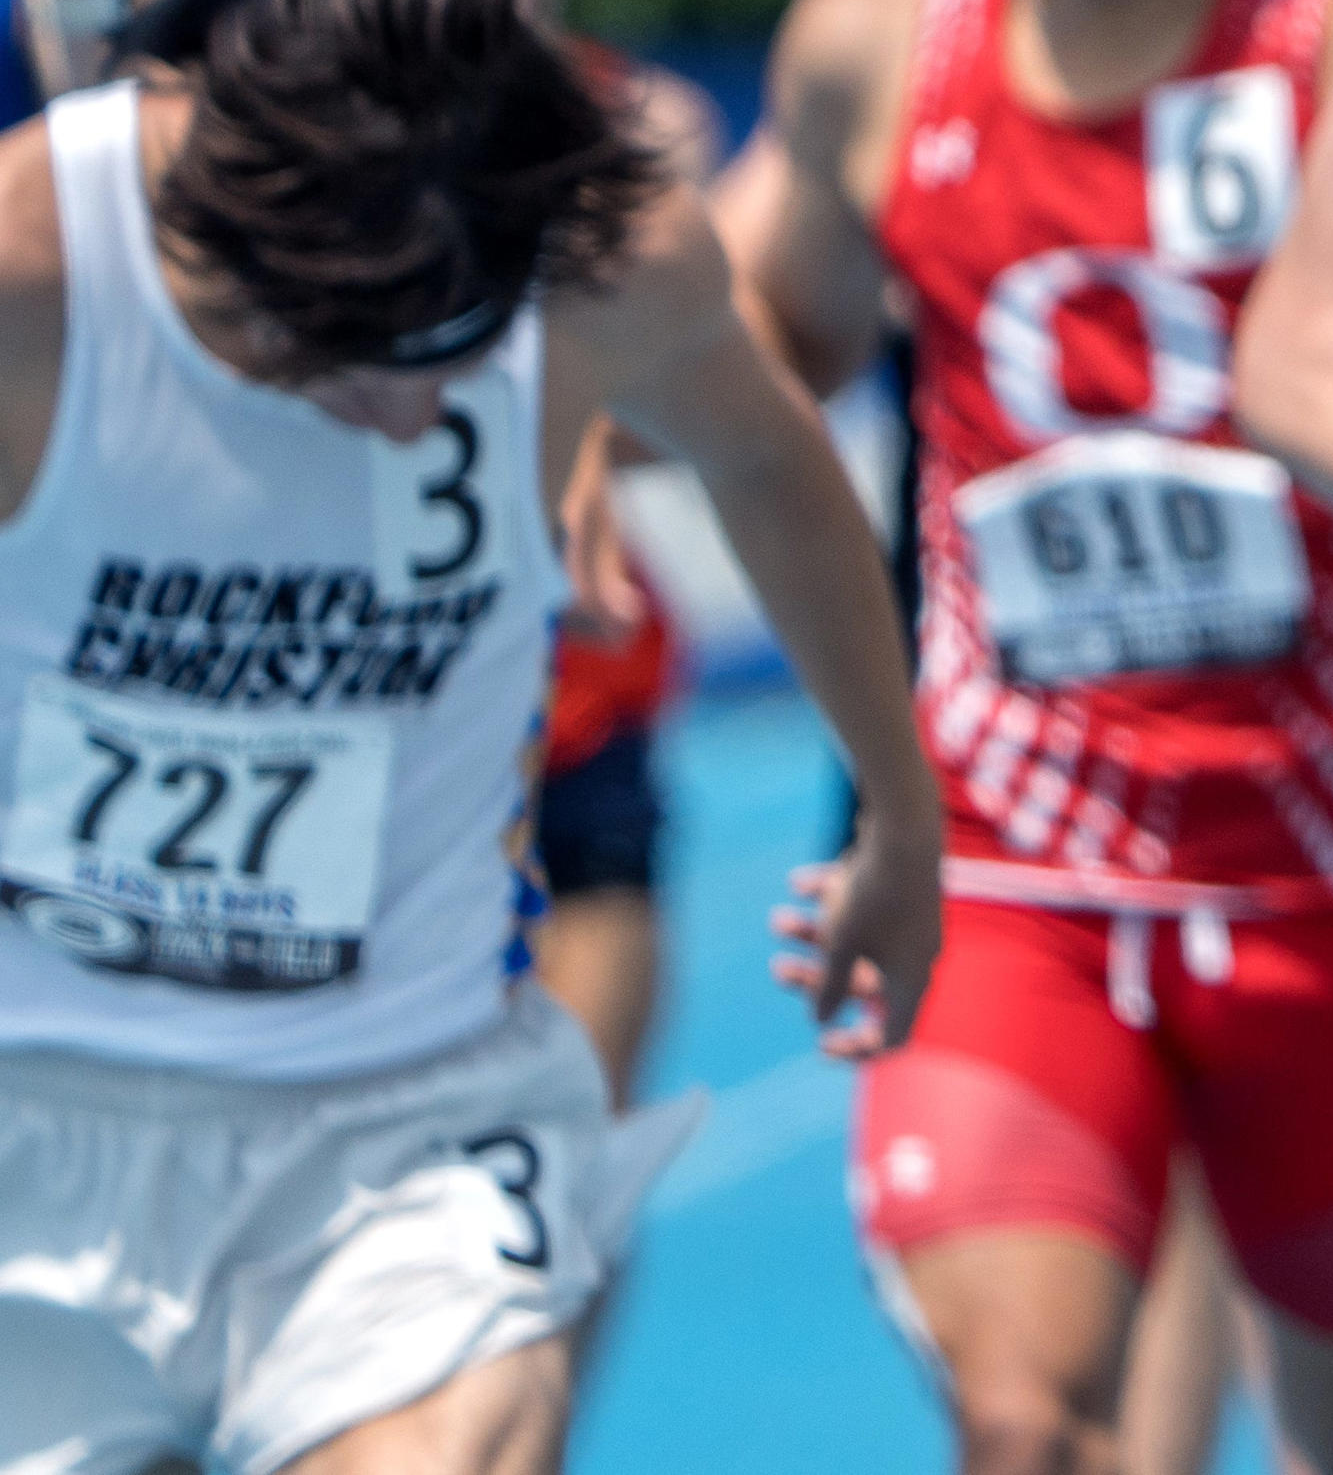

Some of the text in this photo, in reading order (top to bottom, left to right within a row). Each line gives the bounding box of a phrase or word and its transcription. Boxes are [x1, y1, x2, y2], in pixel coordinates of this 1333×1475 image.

[1187, 93, 1264, 249] 6
[409, 406, 486, 581] 3
[1023, 488, 1232, 576] 610
[74, 727, 315, 875] 727
[460, 1125, 550, 1271] 3
